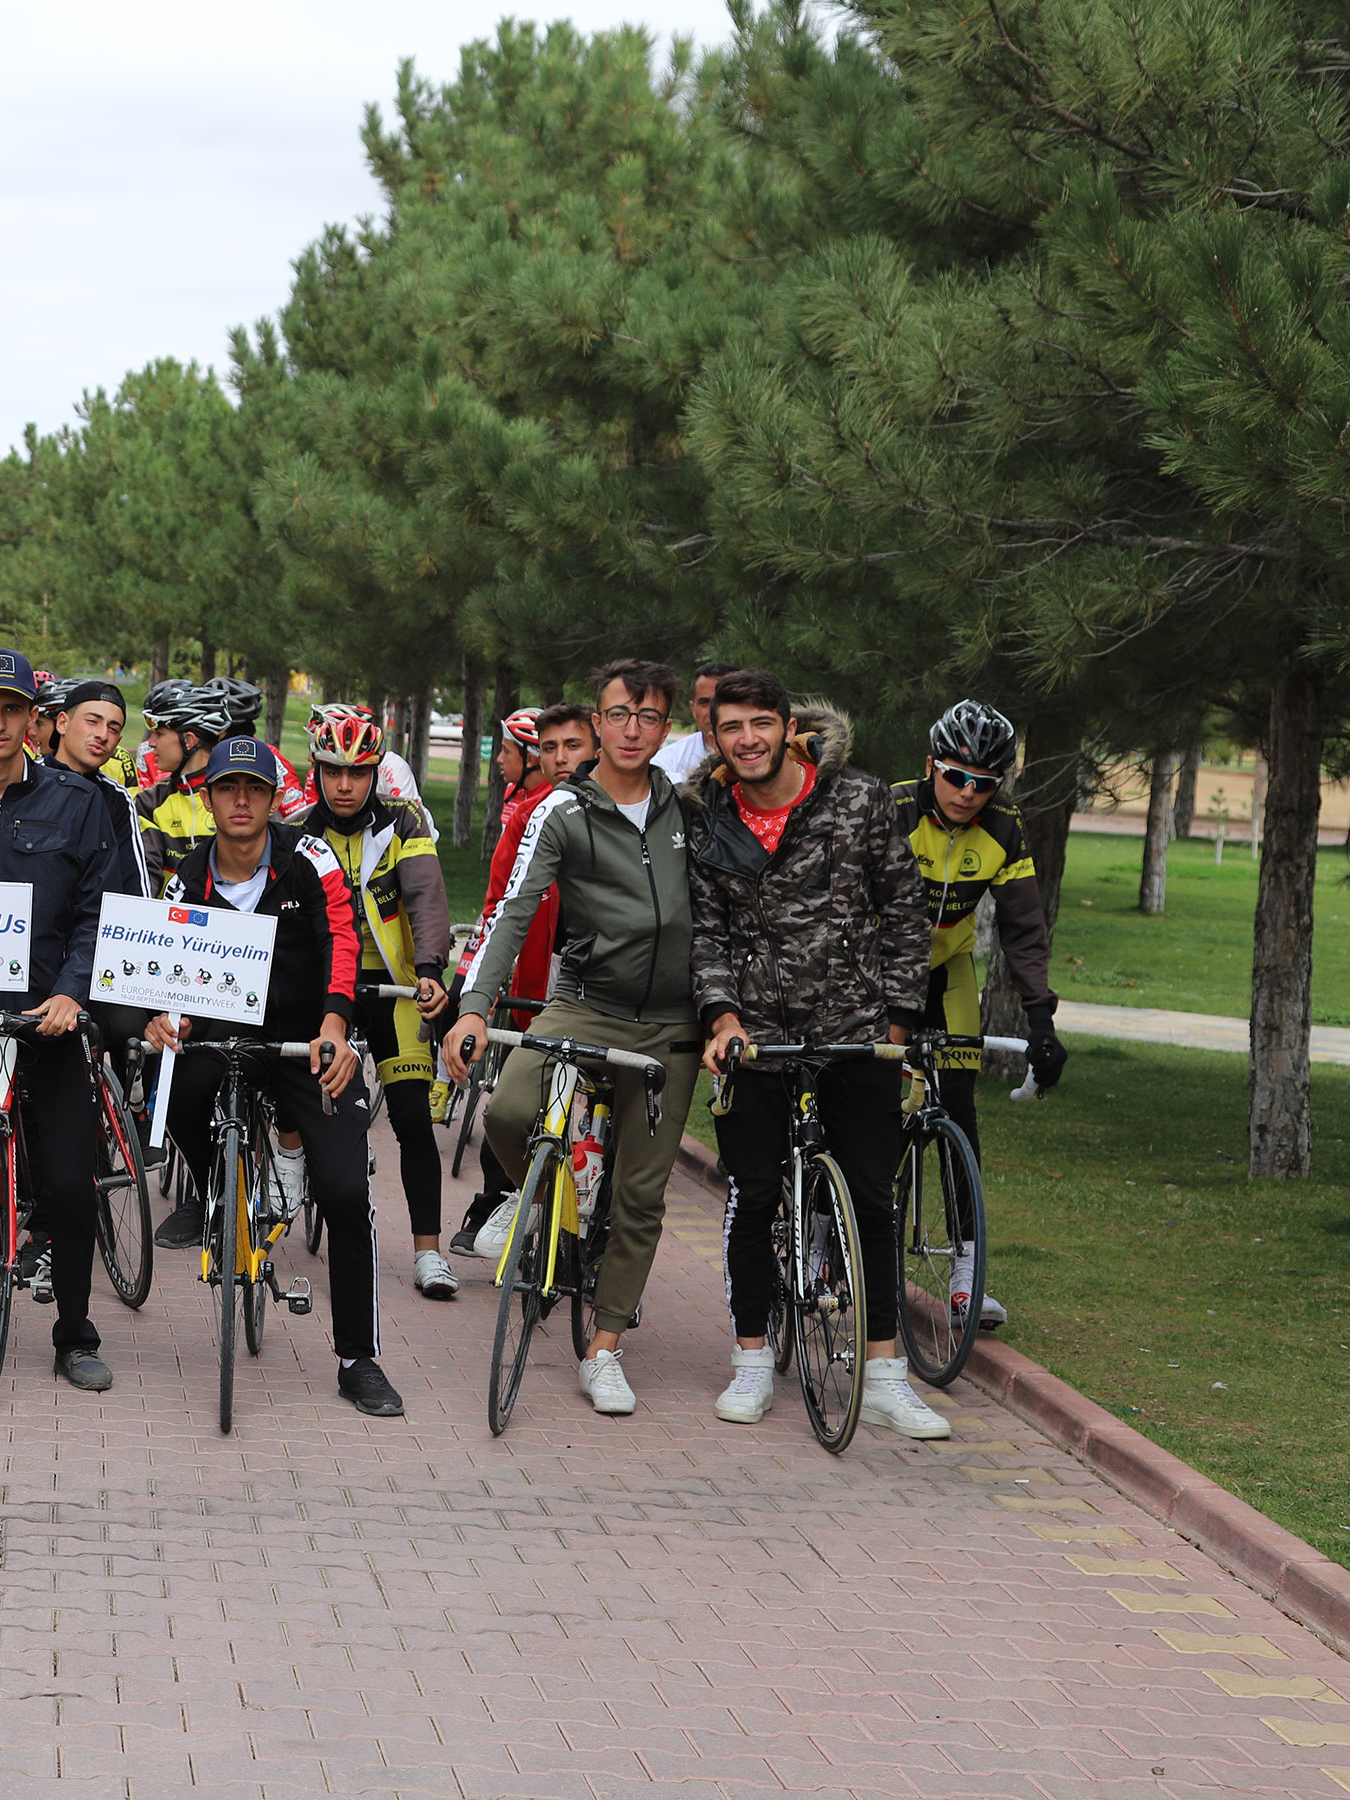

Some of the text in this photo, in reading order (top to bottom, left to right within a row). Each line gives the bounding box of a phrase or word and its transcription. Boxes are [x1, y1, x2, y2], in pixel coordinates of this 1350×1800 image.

[566, 805, 581, 815] adida
[101, 924, 269, 962] #Birlikte Yürüyelim
[121, 985, 236, 1009] EUROPEANMOBILITYWEEK
[136, 995, 172, 1007] SEPTEMBER
[392, 1063, 432, 1074] KONYA
